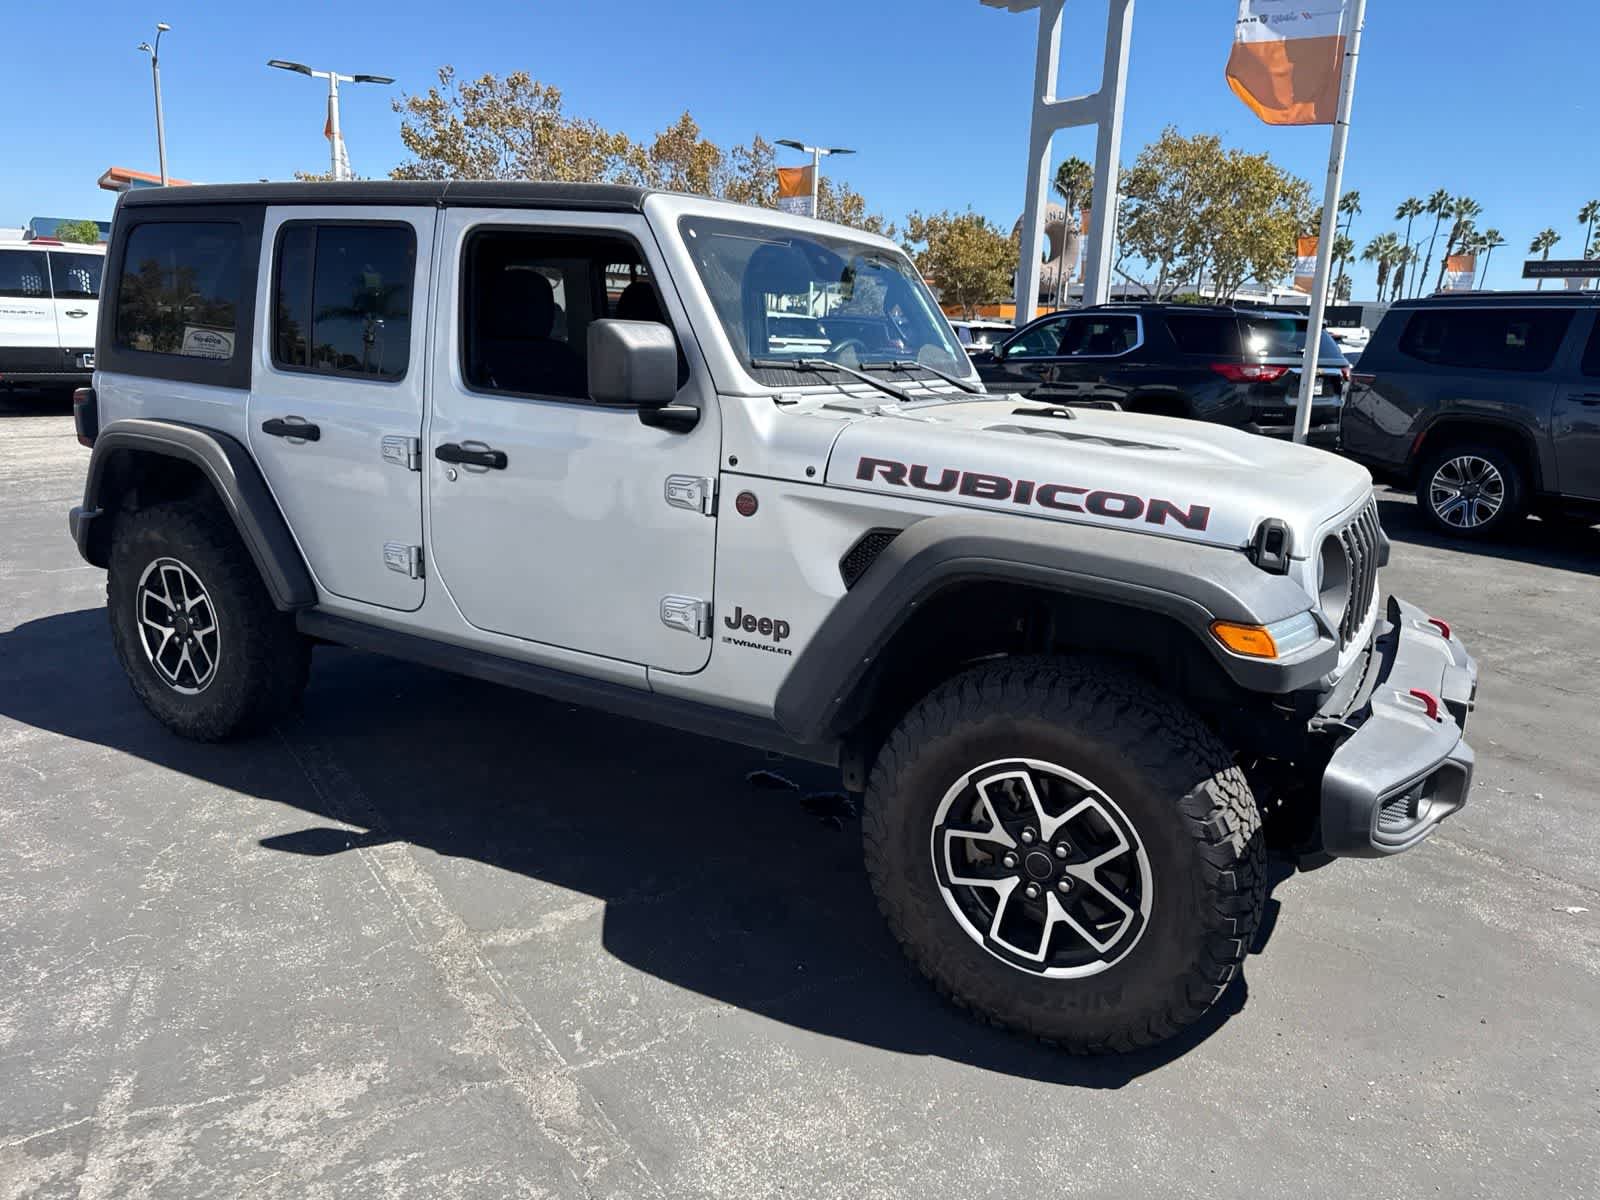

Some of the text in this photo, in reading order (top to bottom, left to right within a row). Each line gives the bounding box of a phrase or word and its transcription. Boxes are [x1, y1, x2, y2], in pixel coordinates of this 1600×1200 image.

[855, 456, 1211, 531] RUBICON
[724, 606, 790, 642] Jeep
[733, 638, 792, 656] WRANGLER
